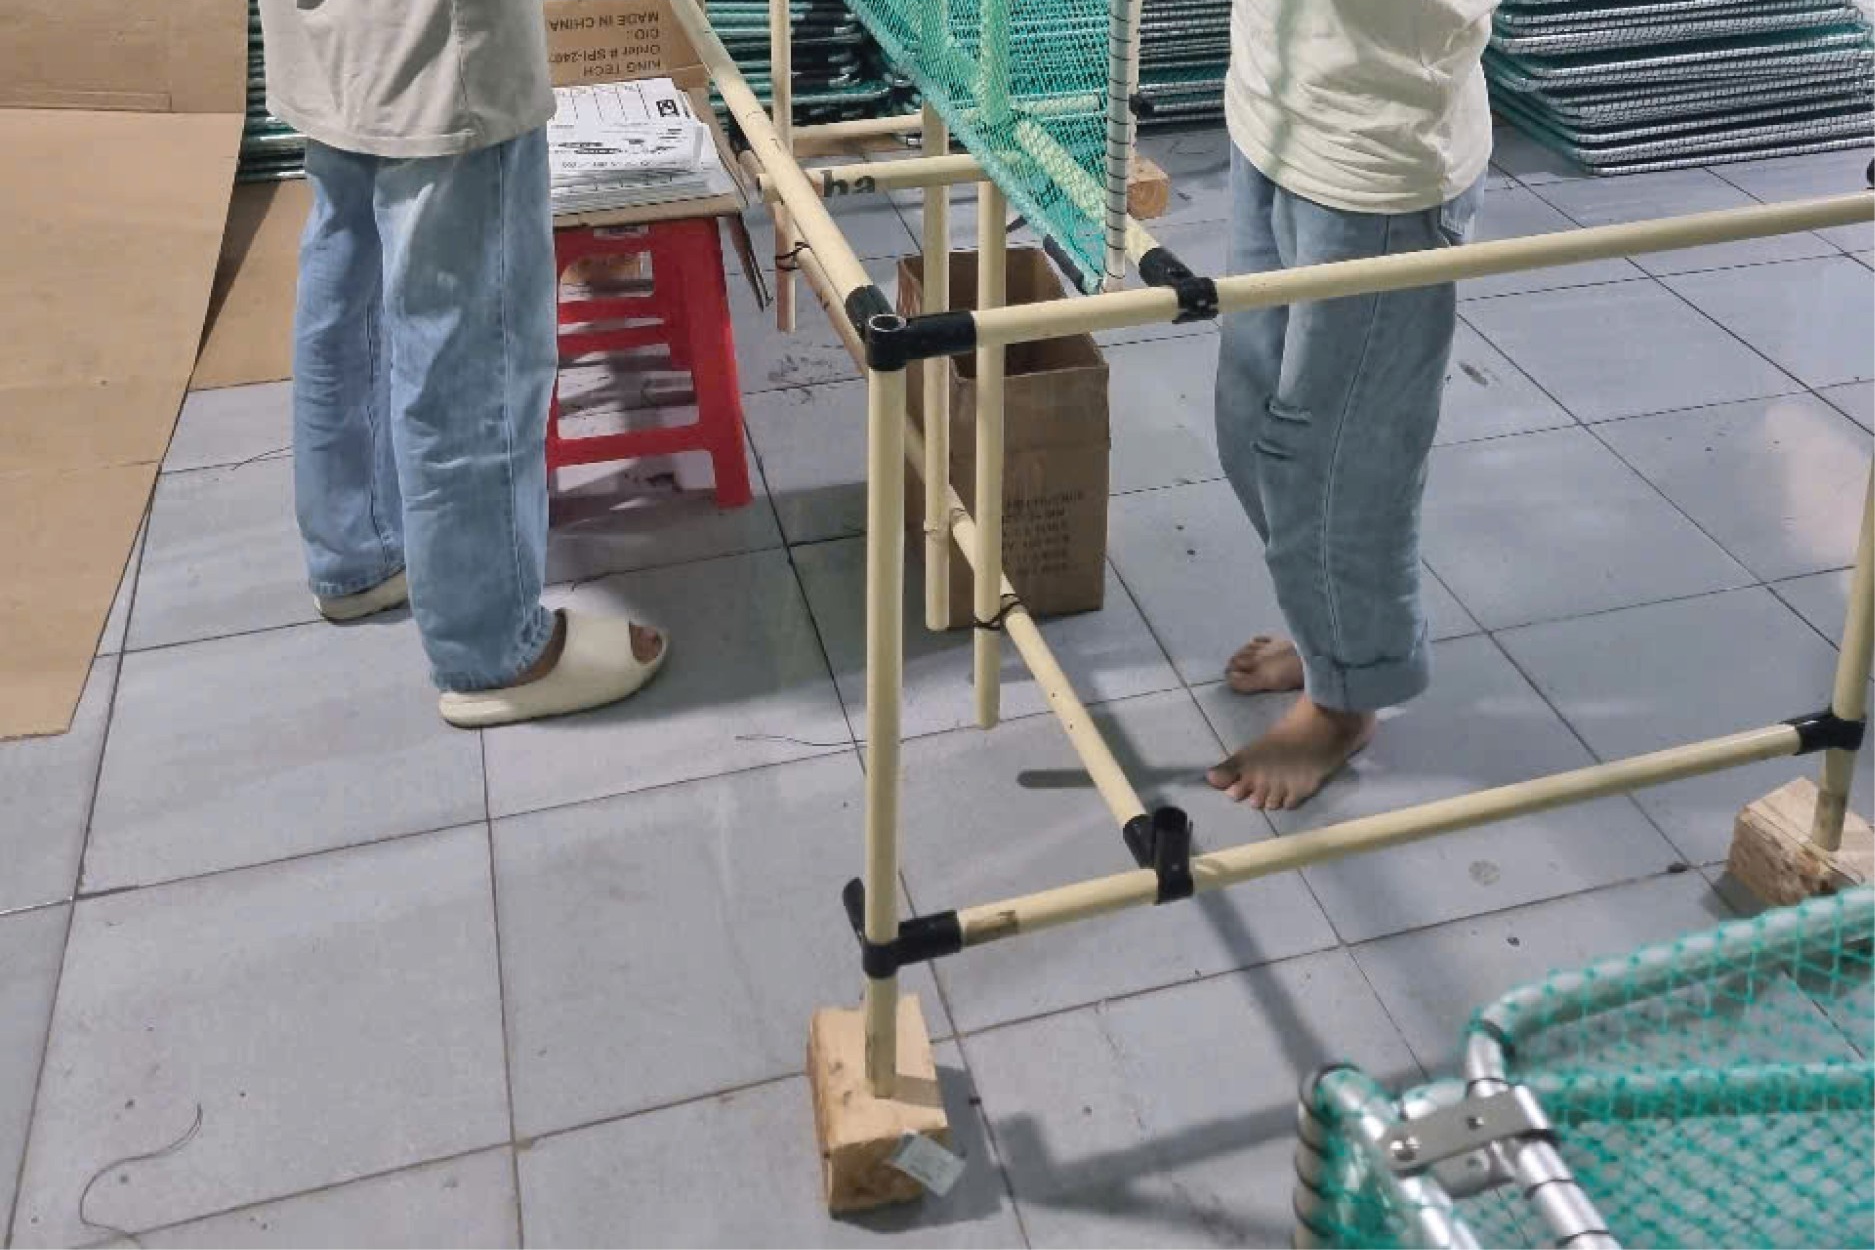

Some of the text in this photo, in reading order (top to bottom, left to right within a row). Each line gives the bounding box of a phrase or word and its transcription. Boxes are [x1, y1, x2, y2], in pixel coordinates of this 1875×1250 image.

[549, 11, 659, 32] MADE IN CHINA
[610, 48, 618, 59] #
[623, 45, 661, 56] Order
[583, 58, 661, 77] KING TECH
